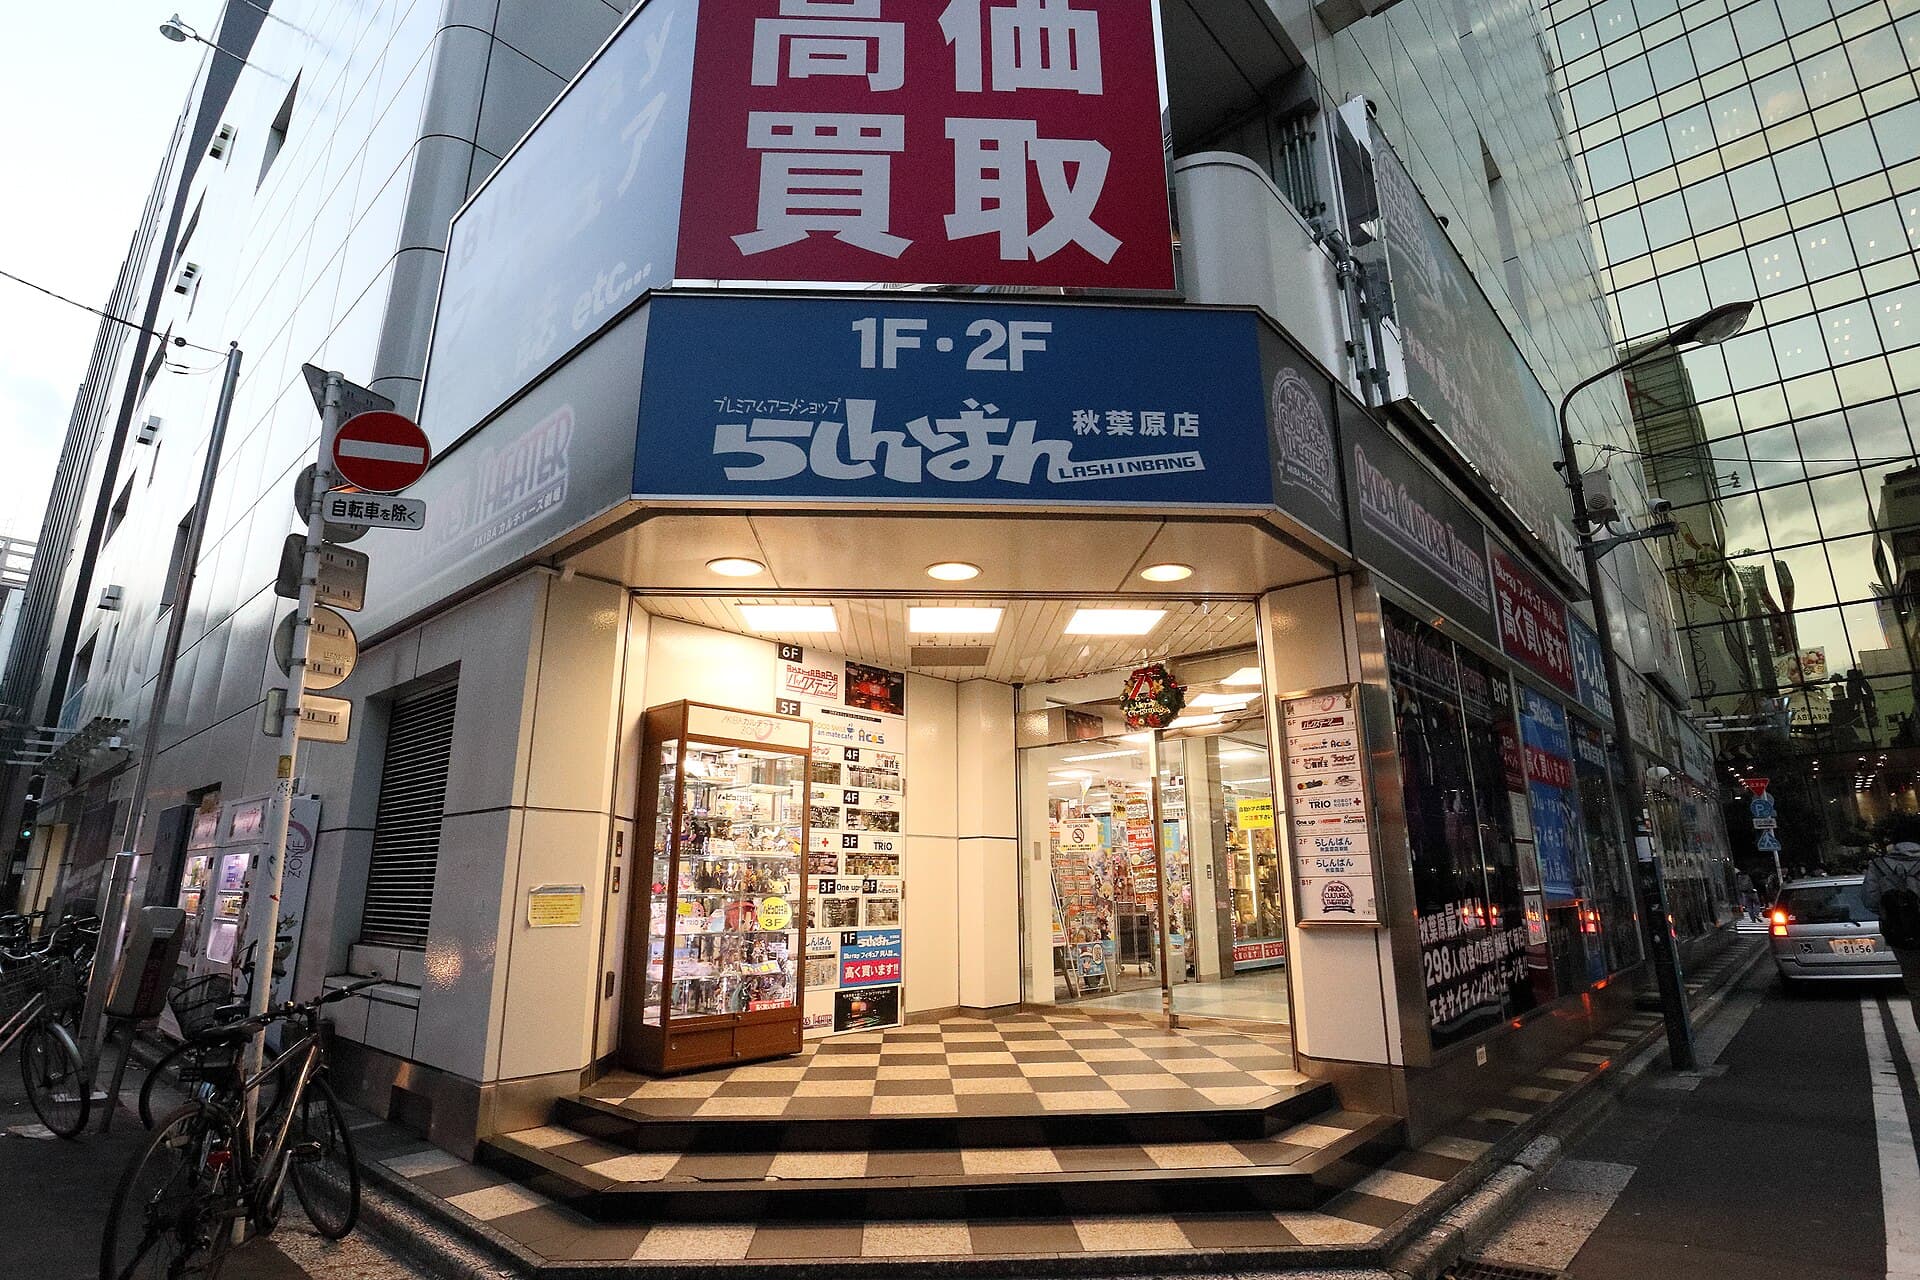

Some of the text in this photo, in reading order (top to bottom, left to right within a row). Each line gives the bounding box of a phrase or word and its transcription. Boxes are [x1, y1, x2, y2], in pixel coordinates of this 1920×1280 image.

[730, 110, 1123, 265] 買取
[713, 396, 842, 416] プレミアムアニメショップ
[1072, 409, 1200, 439] 秋葉原店
[713, 398, 1075, 485] らしんばん
[1059, 452, 1197, 480] LASHINBANG
[331, 499, 417, 524] 自転車を除く
[782, 646, 799, 659] 6F
[780, 702, 797, 715] 5F
[845, 749, 858, 761] 4F
[844, 792, 858, 803] 4F
[1308, 800, 1331, 809] TRIO
[843, 836, 857, 847] 3F
[873, 841, 893, 851] TRIO
[1314, 837, 1353, 847] らしんばん
[287, 840, 306, 879] ZONE
[1315, 858, 1354, 868] らしんばん
[820, 881, 834, 893] 3F
[765, 918, 783, 927] 3F
[842, 932, 856, 944] 1F
[1843, 945, 1872, 954] 81-56
[844, 963, 899, 980] 高く買います!!
